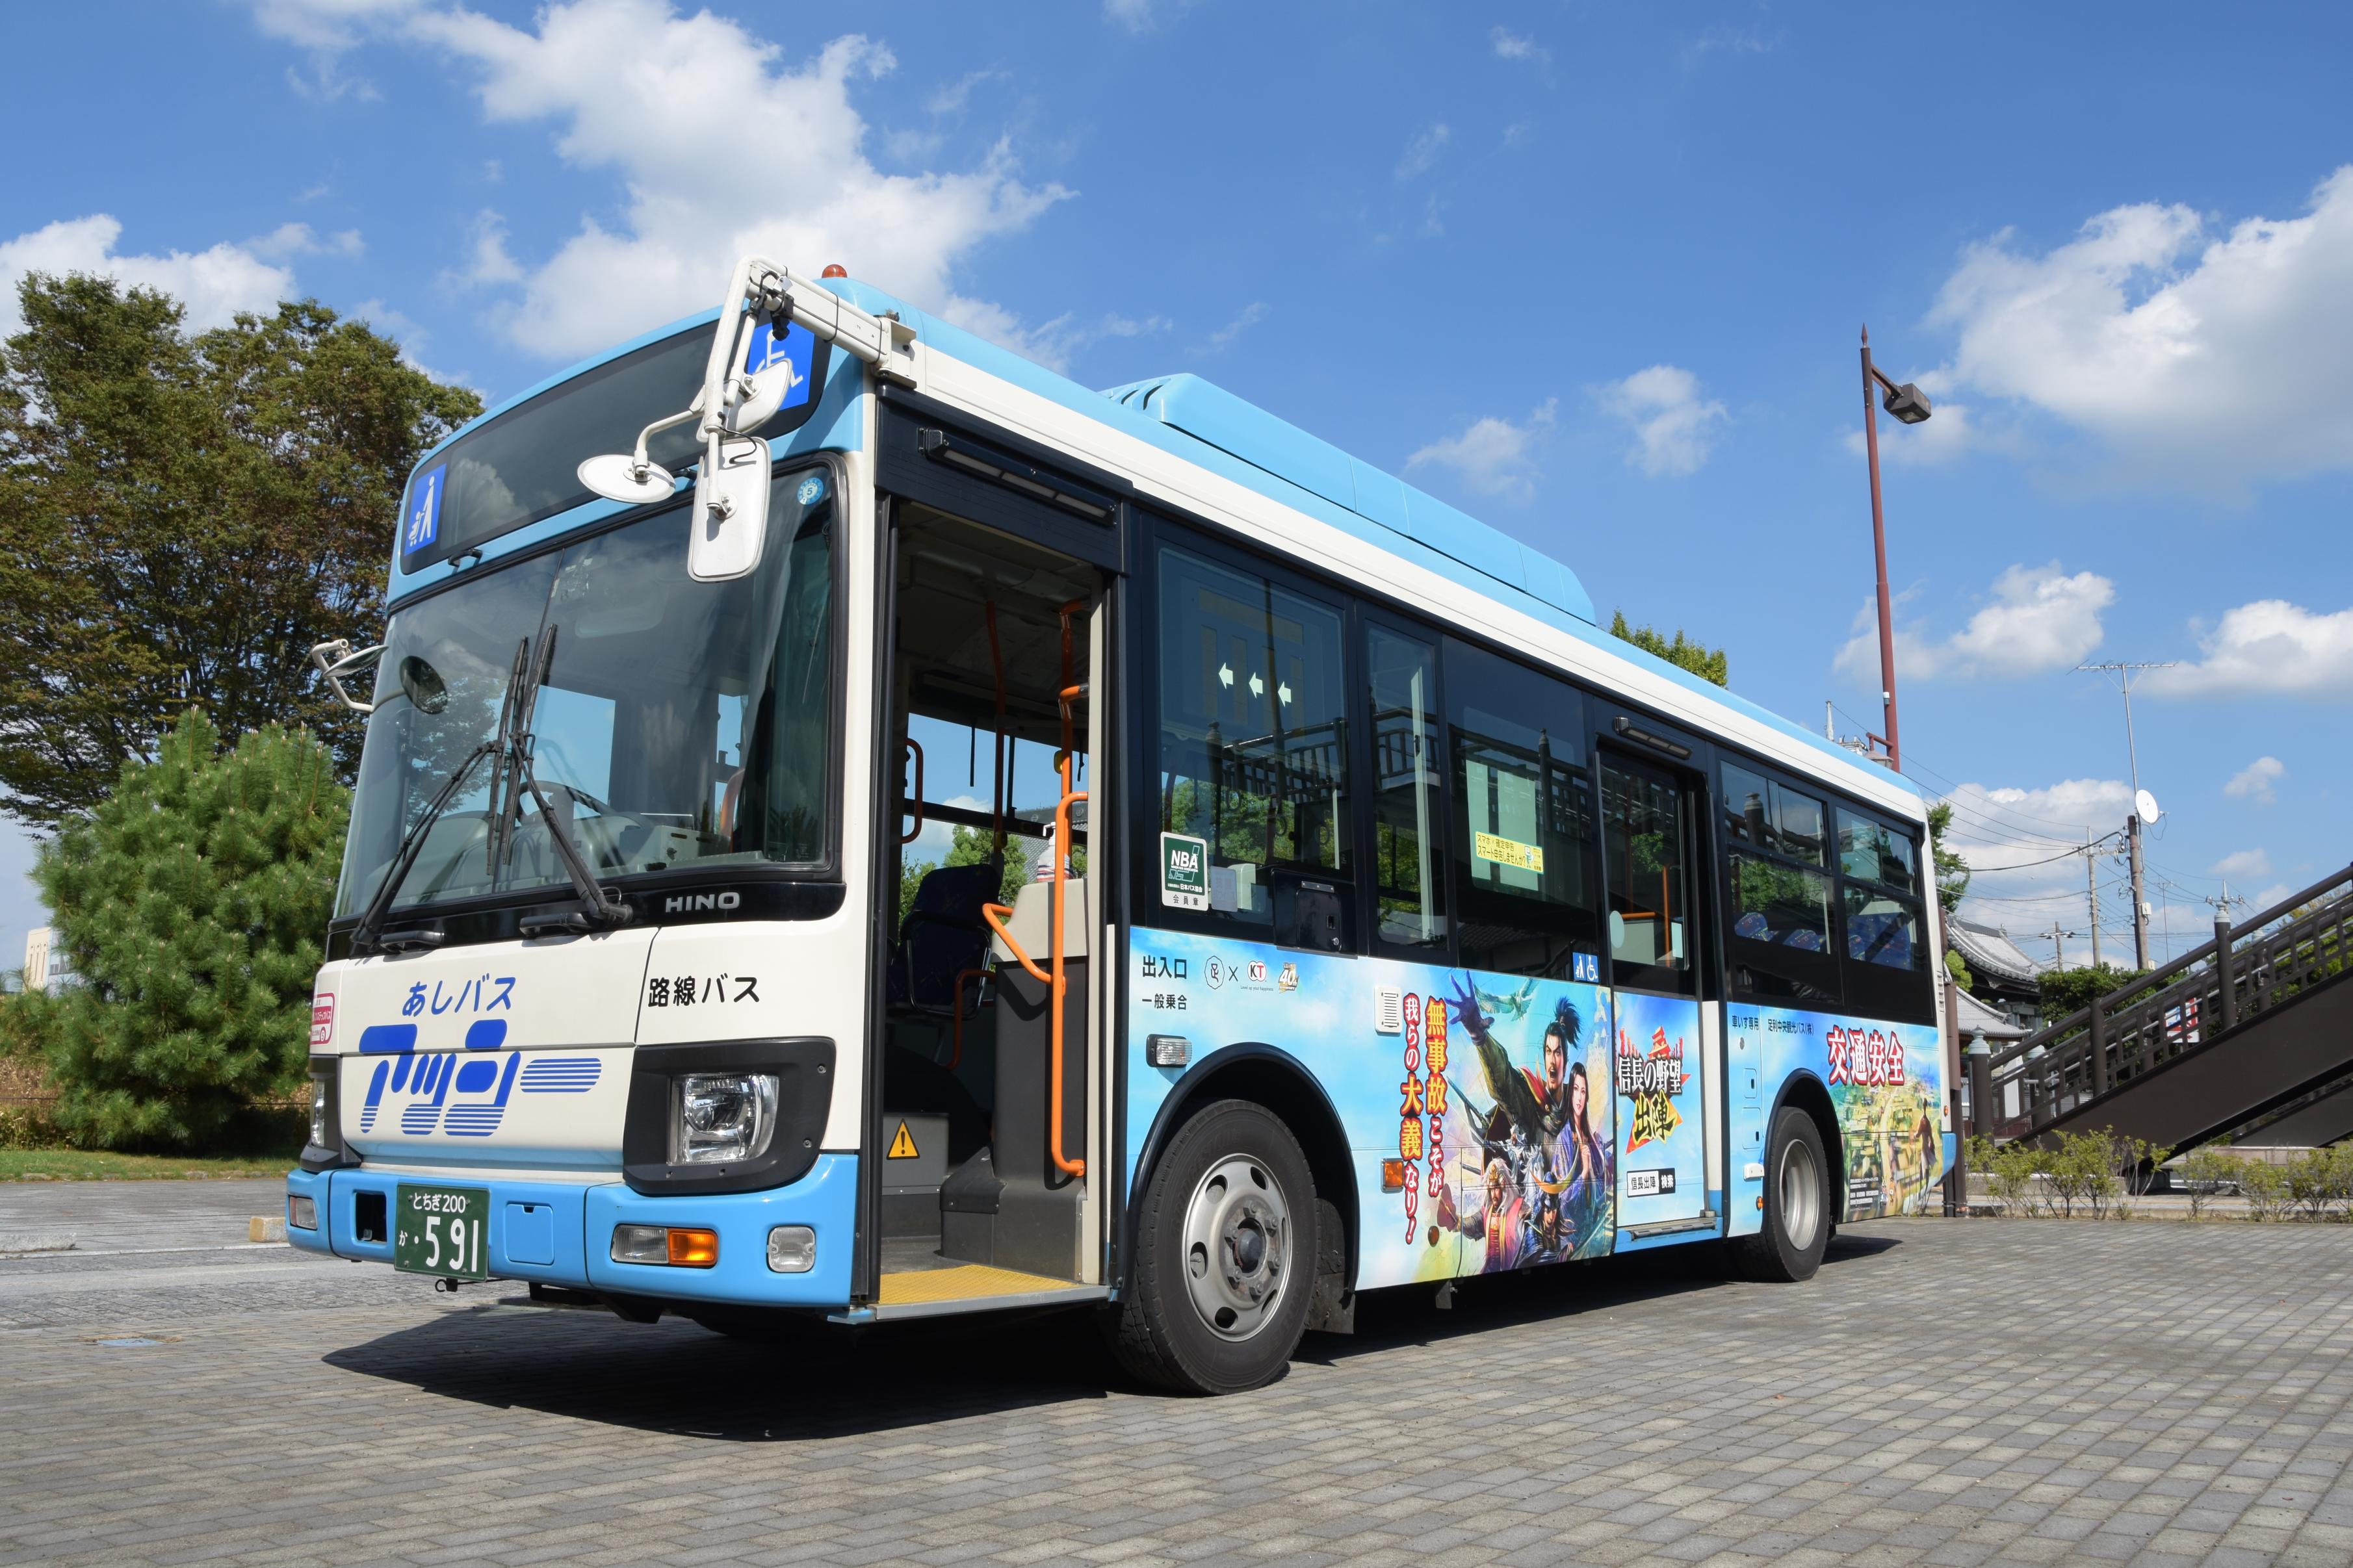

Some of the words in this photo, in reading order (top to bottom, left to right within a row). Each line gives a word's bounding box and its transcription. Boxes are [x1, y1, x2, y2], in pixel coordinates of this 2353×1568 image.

[1171, 849, 1199, 869] NBA
[665, 892, 740, 913] HINO
[1142, 955, 1187, 979] 出入口
[401, 973, 516, 1017] あしバス
[648, 973, 760, 1007] 路線バス
[1142, 993, 1187, 1010] 一般乗合
[1732, 1015, 1759, 1031] 車いす専用
[1827, 1025, 1904, 1085] 交通安全
[1618, 1057, 1682, 1094] 信長の野望
[1427, 997, 1446, 1196] 無事故こそが
[1632, 1092, 1677, 1144] 出陣
[1631, 1176, 1657, 1190] 信長出陣
[1661, 1174, 1674, 1189] 検索
[398, 1230, 408, 1247] か
